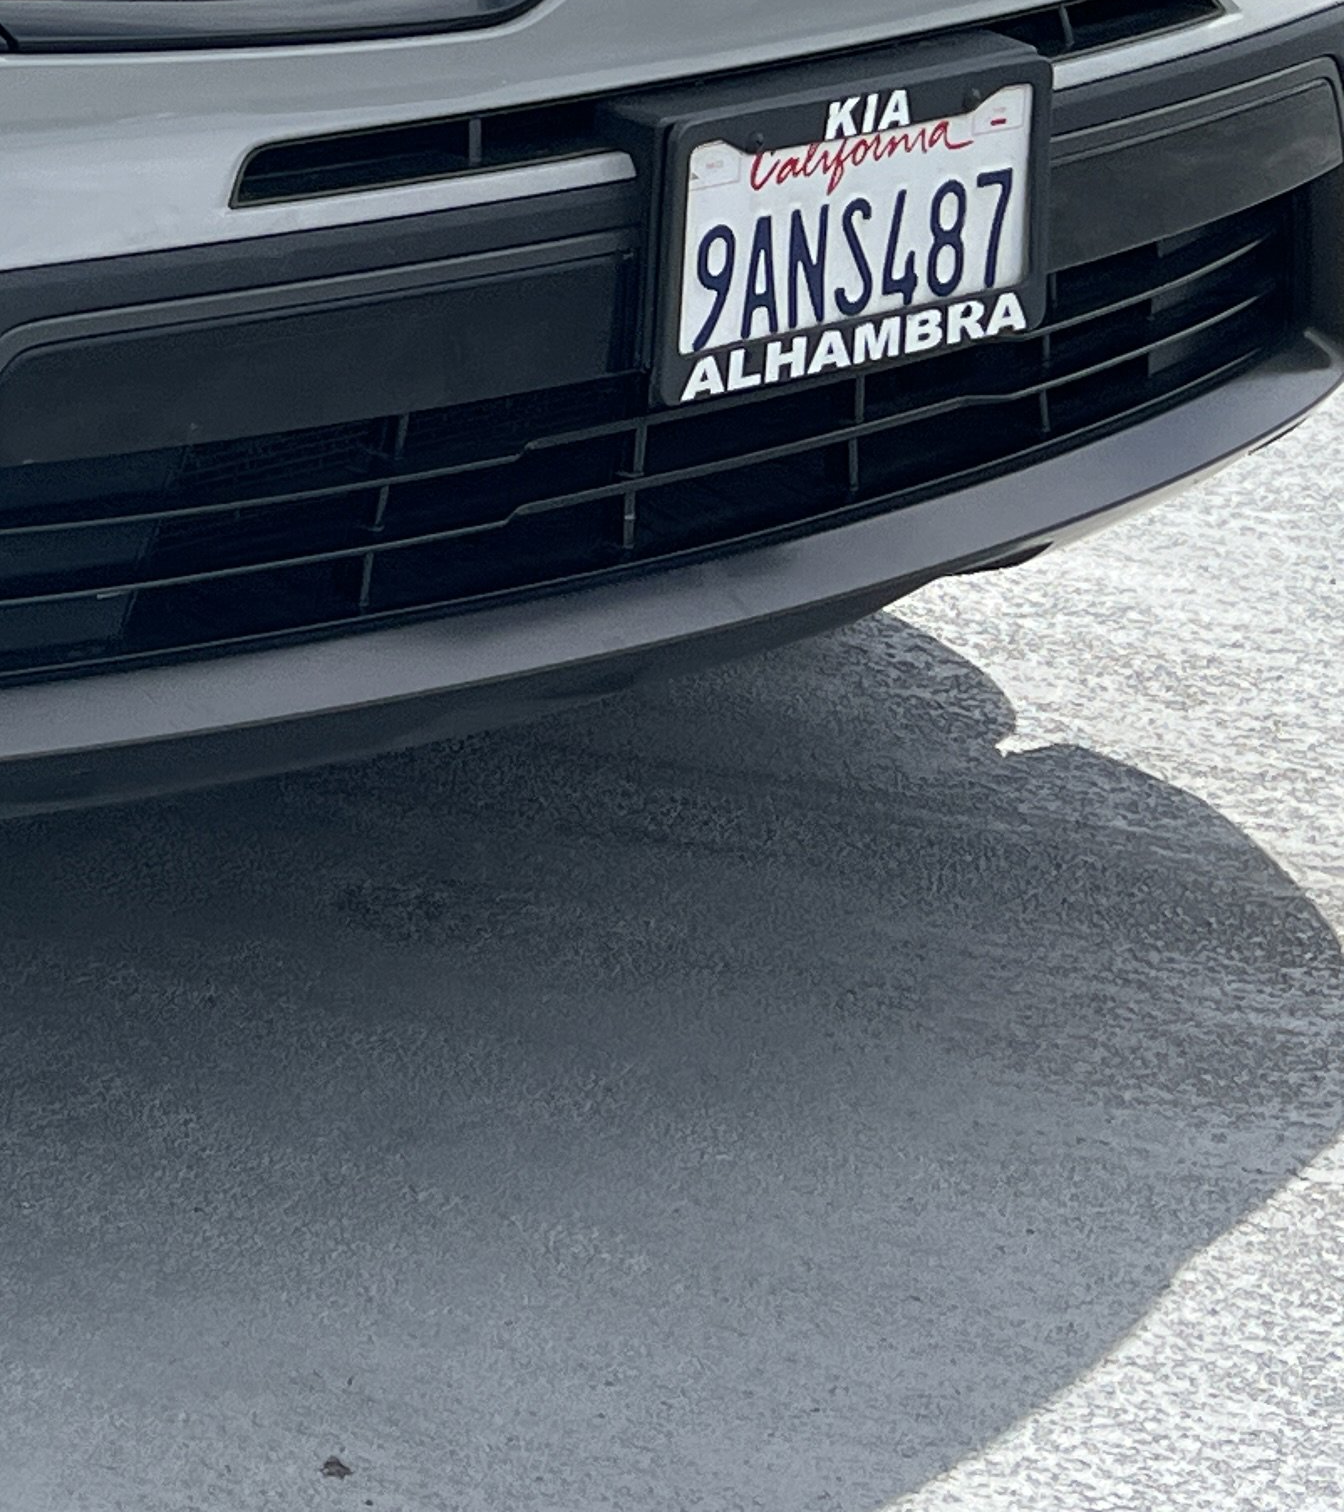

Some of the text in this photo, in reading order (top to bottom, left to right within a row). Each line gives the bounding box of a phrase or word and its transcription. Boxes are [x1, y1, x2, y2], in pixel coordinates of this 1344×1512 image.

[750, 118, 976, 194] California
[824, 88, 911, 140] KIA
[691, 167, 1014, 351] 9ANS487
[679, 292, 1028, 402] ALHAMBRA
